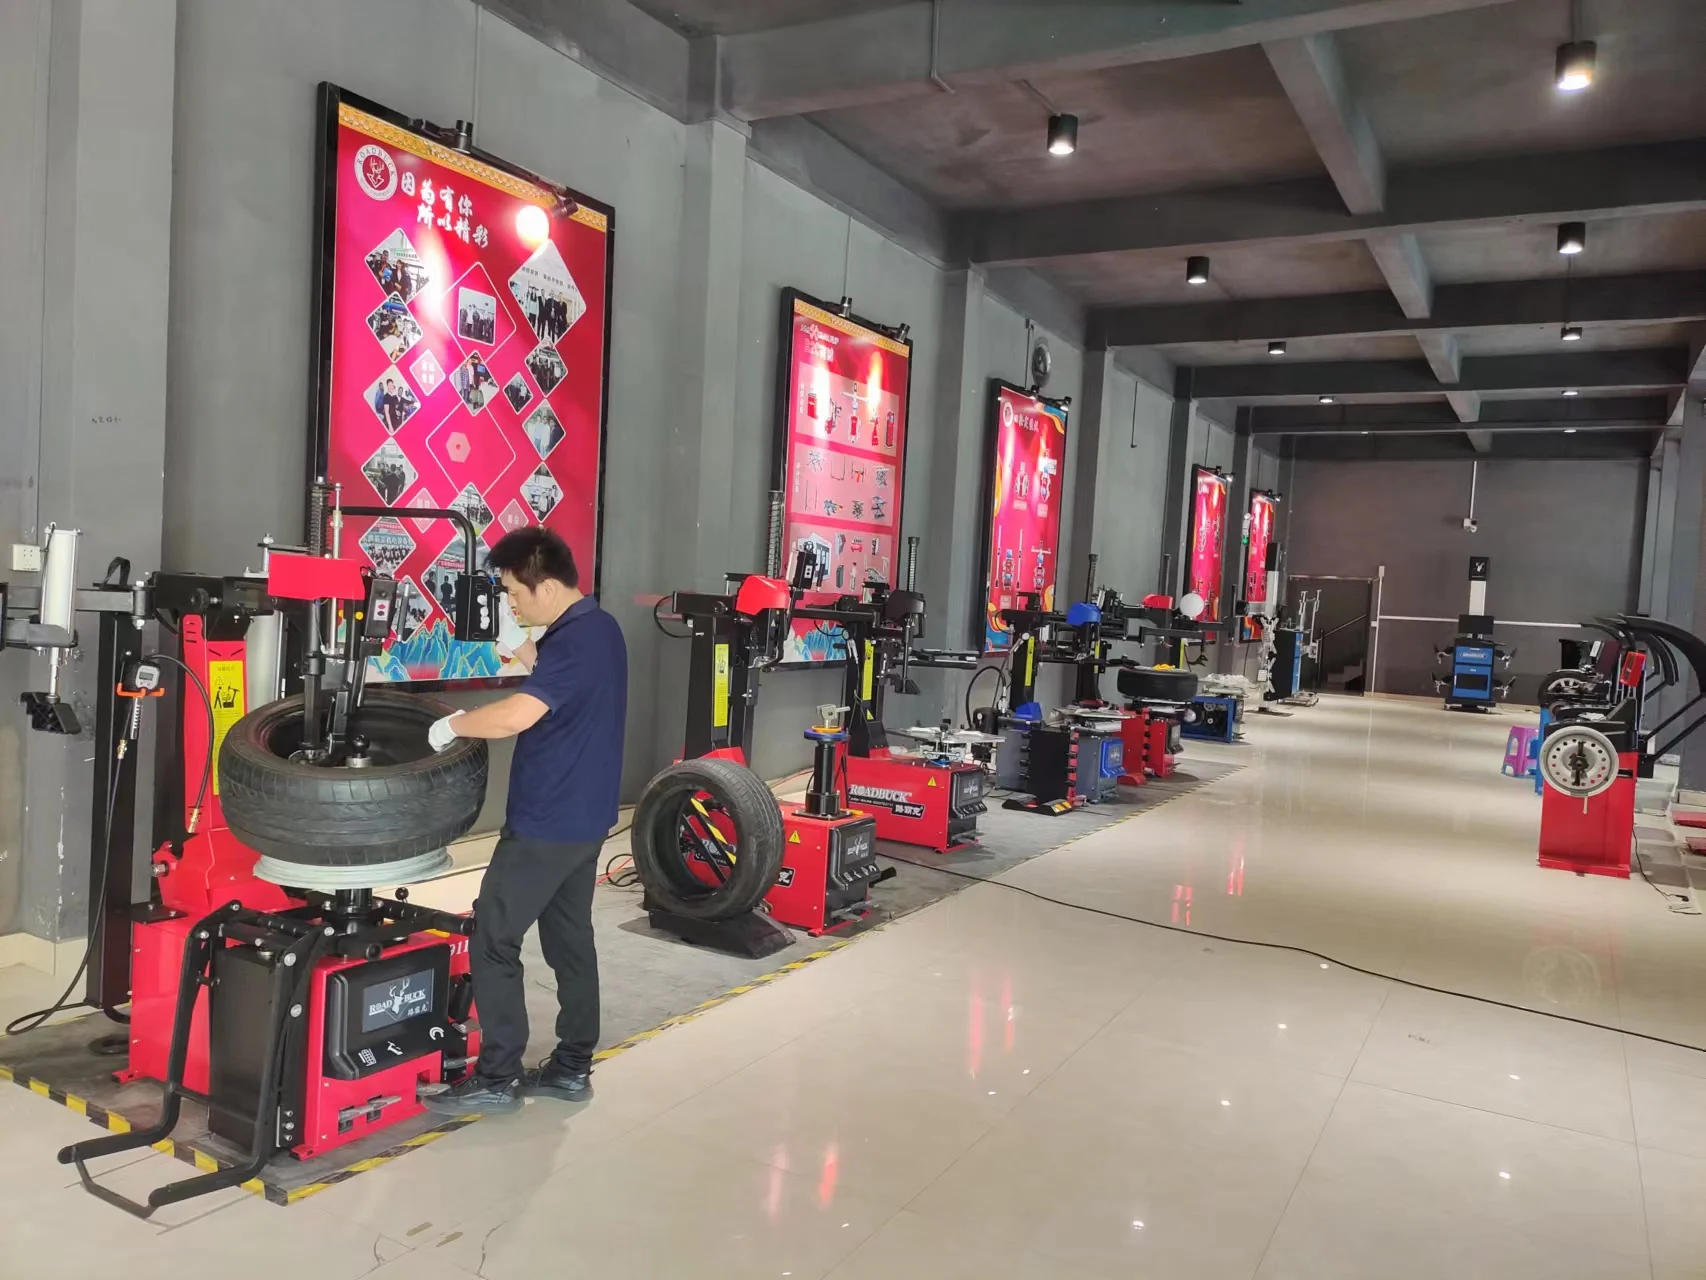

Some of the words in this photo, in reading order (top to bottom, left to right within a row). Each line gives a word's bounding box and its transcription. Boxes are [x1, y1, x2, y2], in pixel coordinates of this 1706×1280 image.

[401, 171, 473, 217] 因为有你
[417, 202, 489, 248] 所以精彩
[849, 784, 909, 803] ROADBUCK
[369, 999, 393, 1016] ROAD
[404, 989, 426, 1003] BUCK
